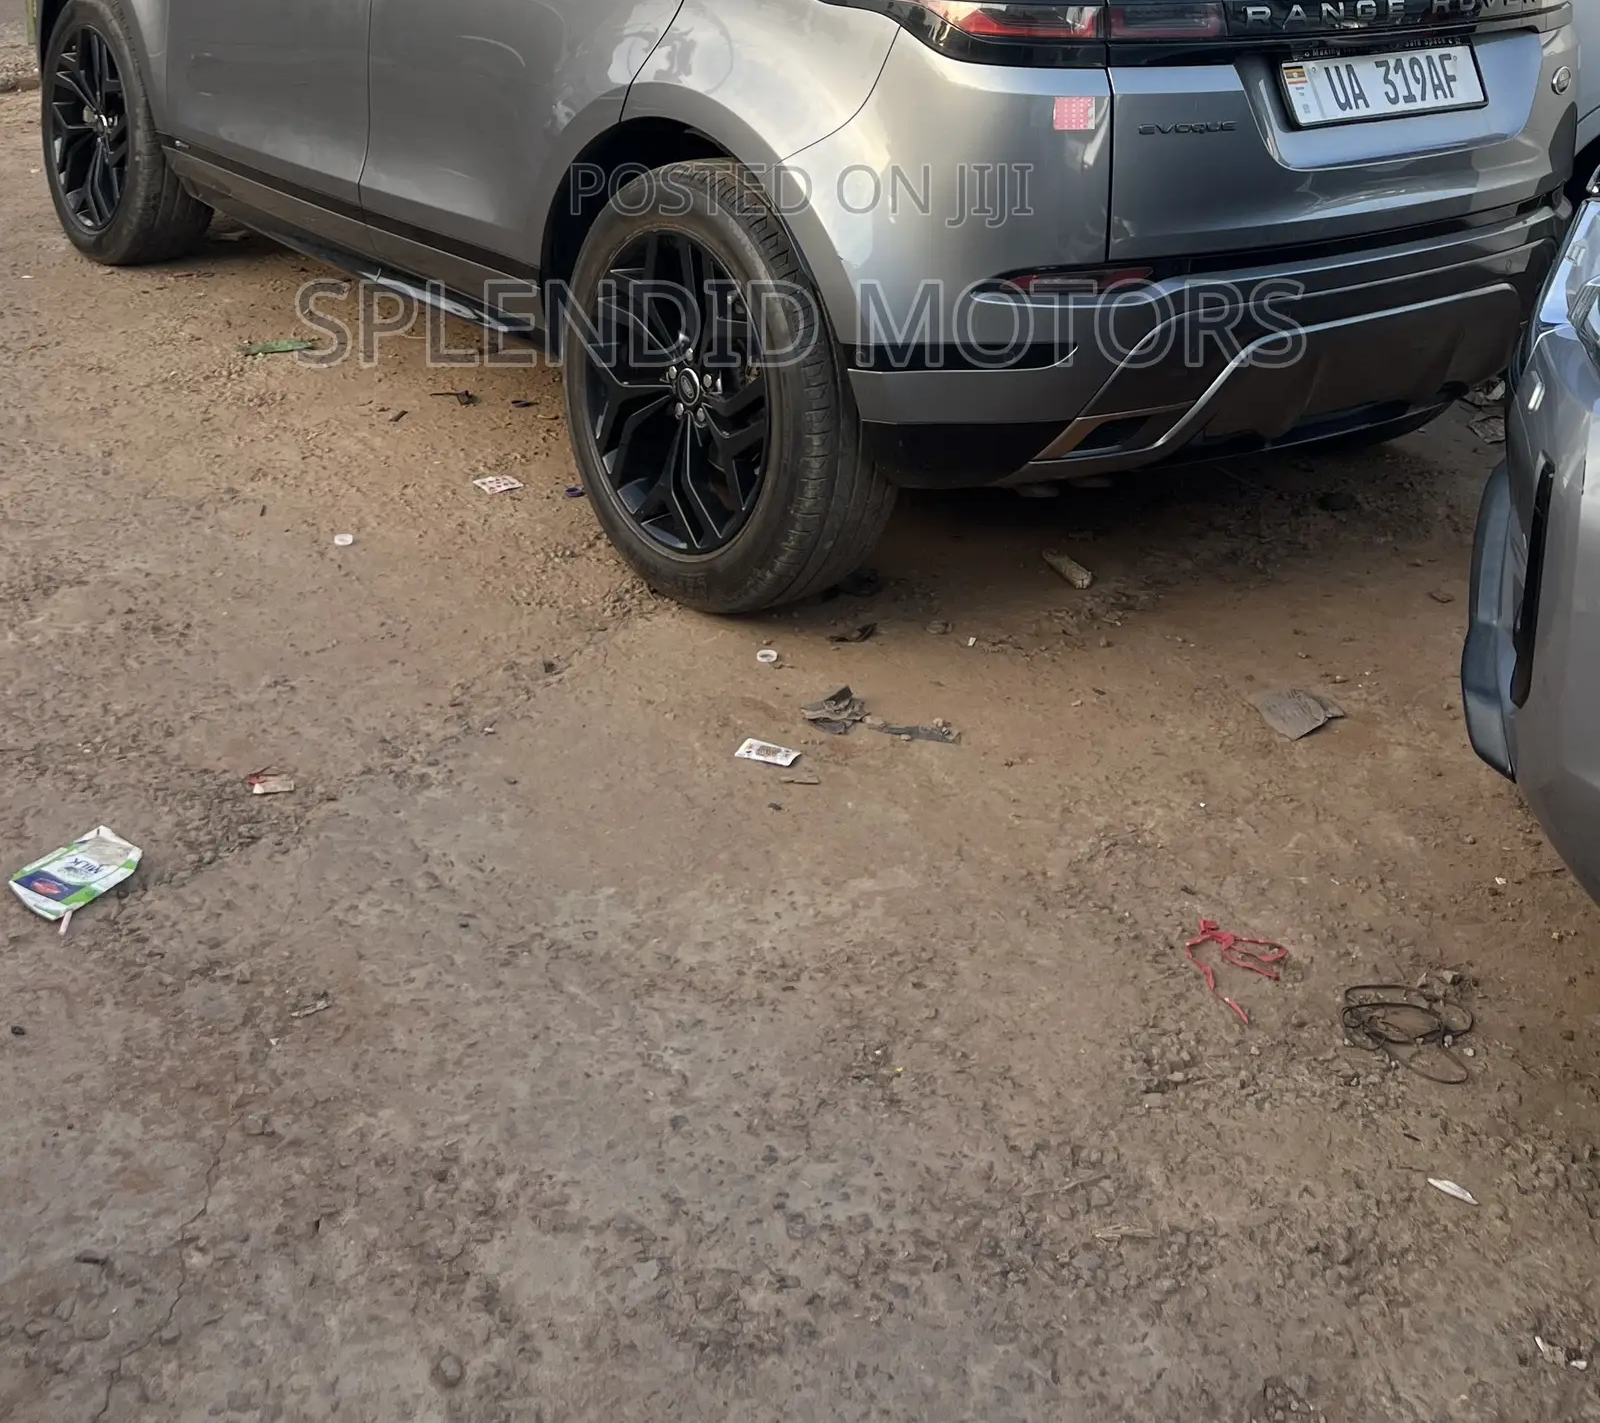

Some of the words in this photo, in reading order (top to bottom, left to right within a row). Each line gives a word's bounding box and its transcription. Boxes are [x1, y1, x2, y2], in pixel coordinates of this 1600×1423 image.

[1324, 64, 1370, 111] UA
[1375, 53, 1458, 106] 319AF
[1138, 121, 1237, 135] EVOQUE
[70, 857, 104, 875] MILK
